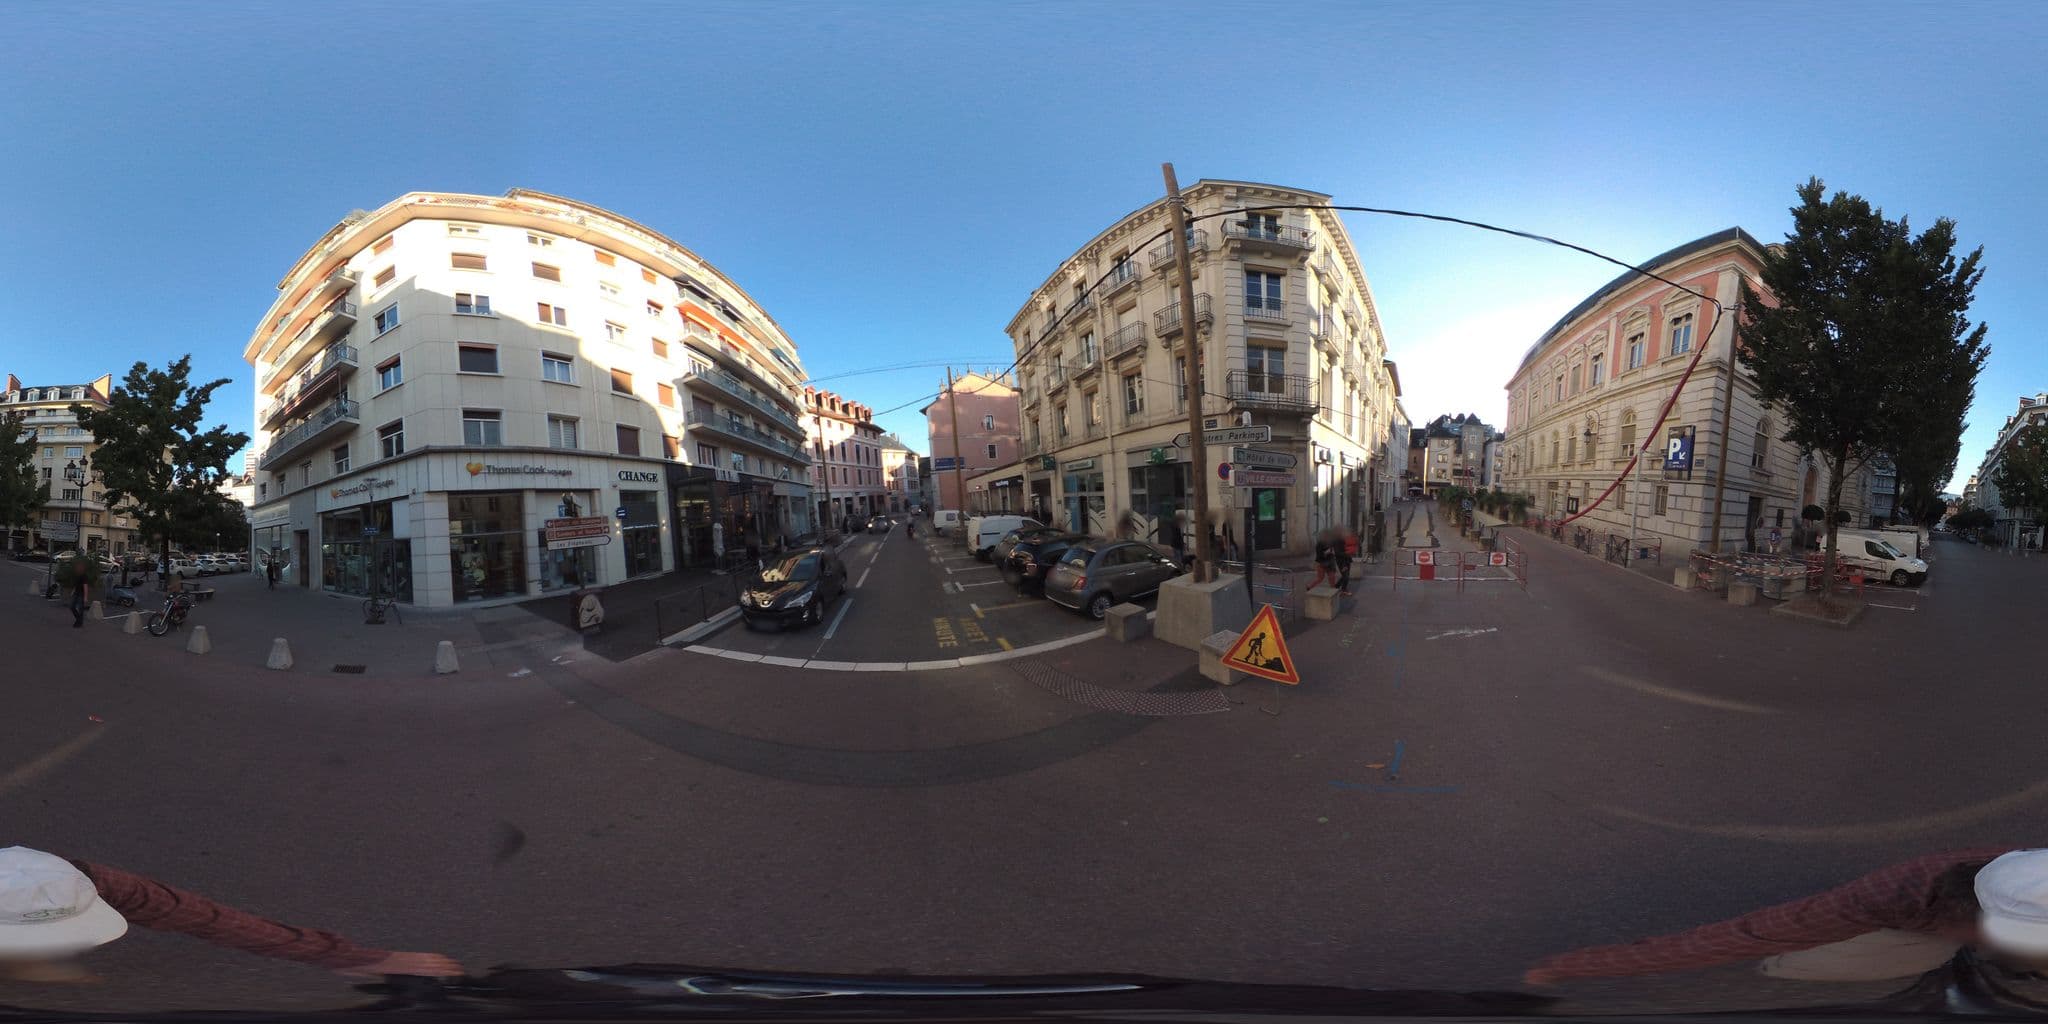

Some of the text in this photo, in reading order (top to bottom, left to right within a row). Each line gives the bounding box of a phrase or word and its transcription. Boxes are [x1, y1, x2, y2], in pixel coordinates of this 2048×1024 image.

[1228, 431, 1265, 441] Parkings
[1668, 438, 1682, 460] P
[486, 464, 520, 475] Thomas
[523, 464, 547, 475] Cook
[618, 470, 659, 483] CHANGE
